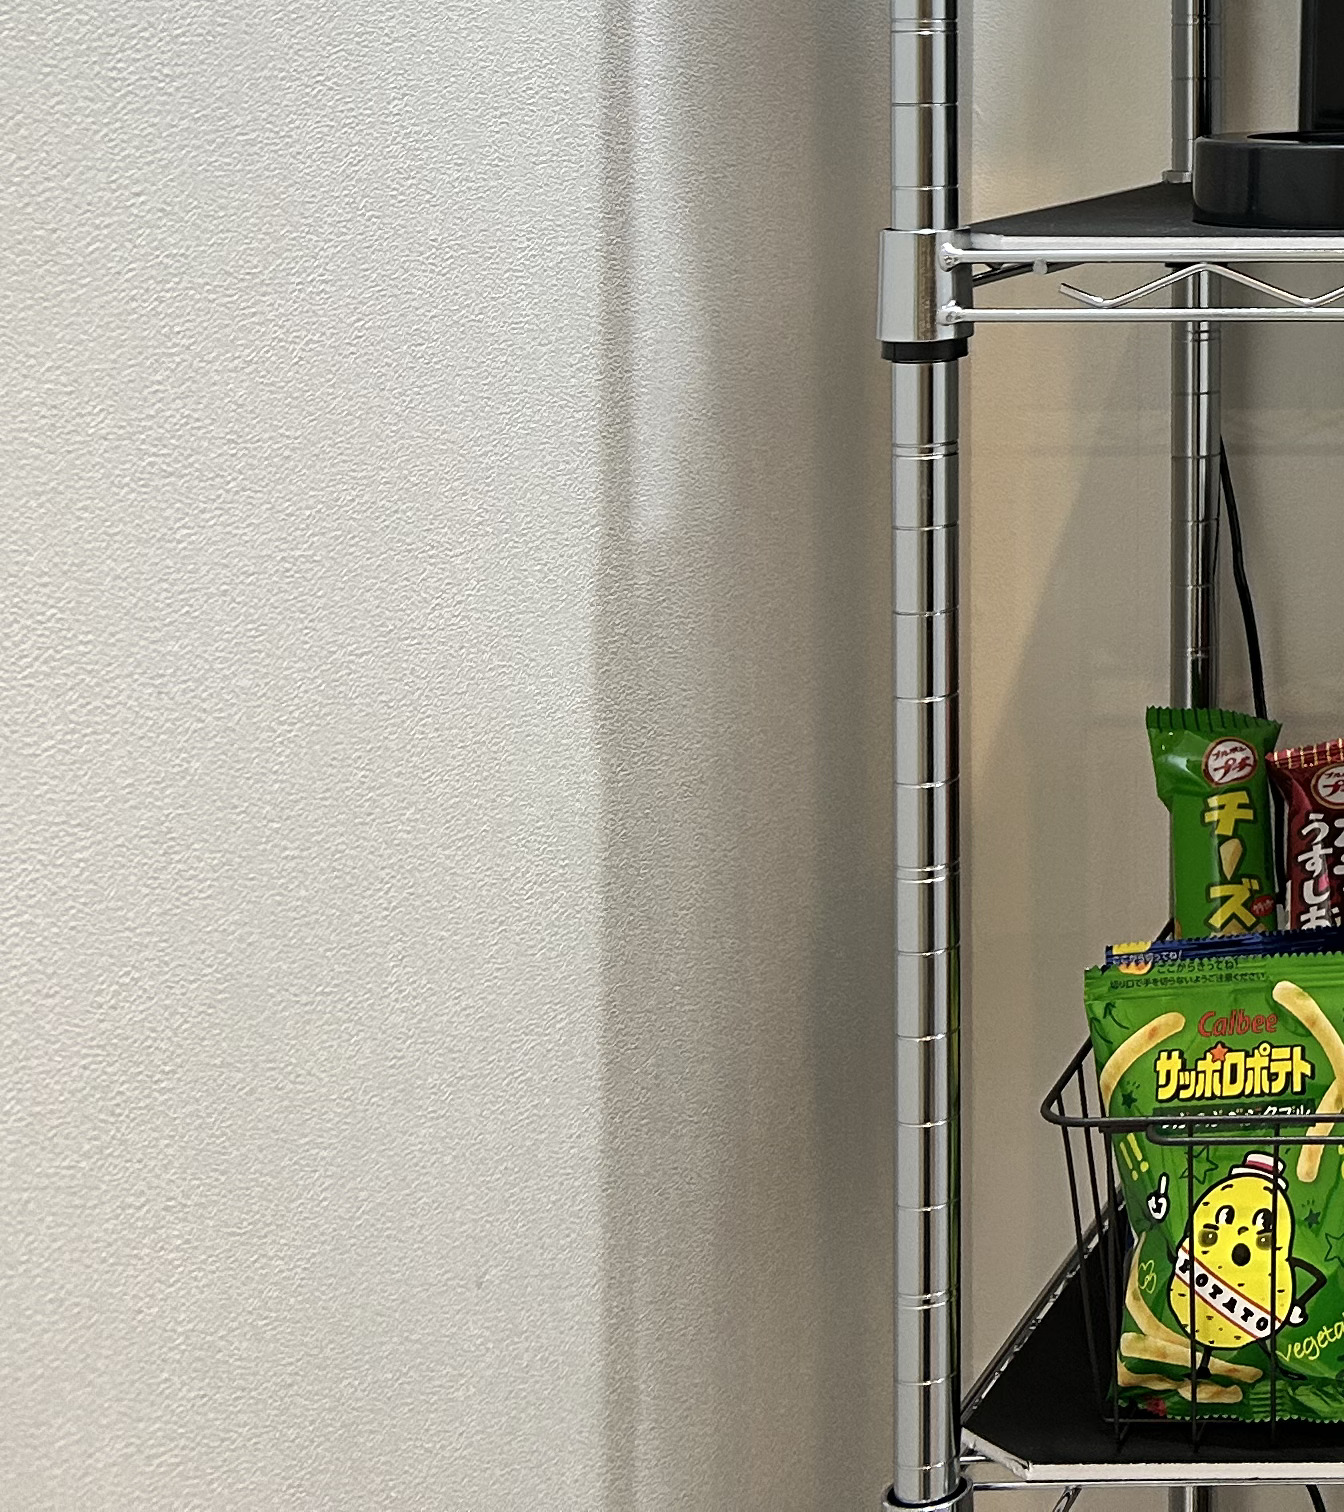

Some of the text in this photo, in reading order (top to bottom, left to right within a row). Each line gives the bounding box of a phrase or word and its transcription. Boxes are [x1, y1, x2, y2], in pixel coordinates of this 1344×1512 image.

[1212, 756, 1254, 782] プチ
[1203, 790, 1261, 930] チーズ
[1197, 1008, 1279, 1038] Calbee
[1155, 1040, 1316, 1102] サッポロポテト
[1178, 1258, 1270, 1332] POTATO
